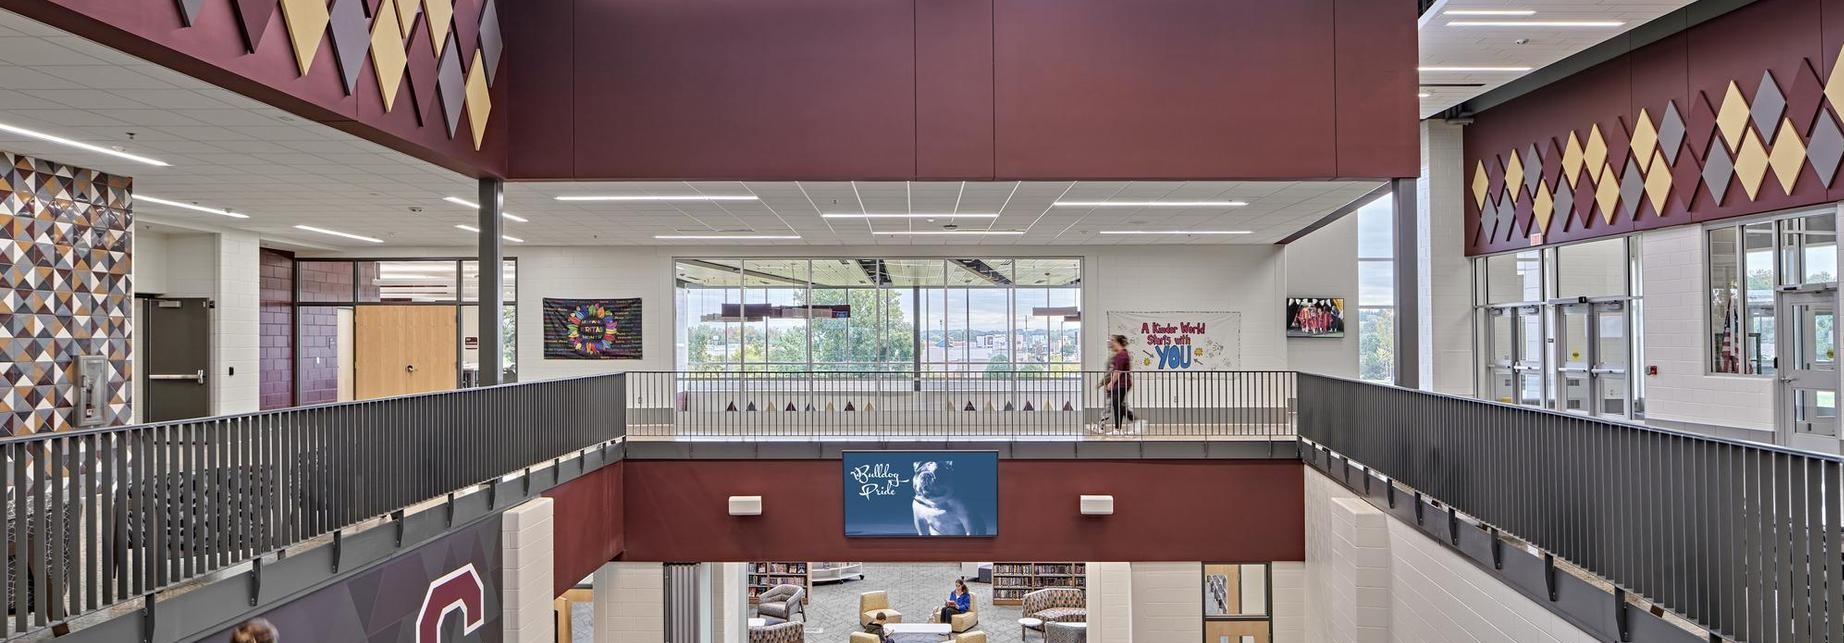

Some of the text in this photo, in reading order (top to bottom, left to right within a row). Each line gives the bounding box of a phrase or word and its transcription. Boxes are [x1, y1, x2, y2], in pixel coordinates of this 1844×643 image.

[1141, 321, 1206, 334] A Kinder World
[1147, 334, 1191, 345] Starts with
[1155, 345, 1192, 369] YOU
[850, 463, 910, 487] Bulldog
[859, 479, 896, 501] Pride
